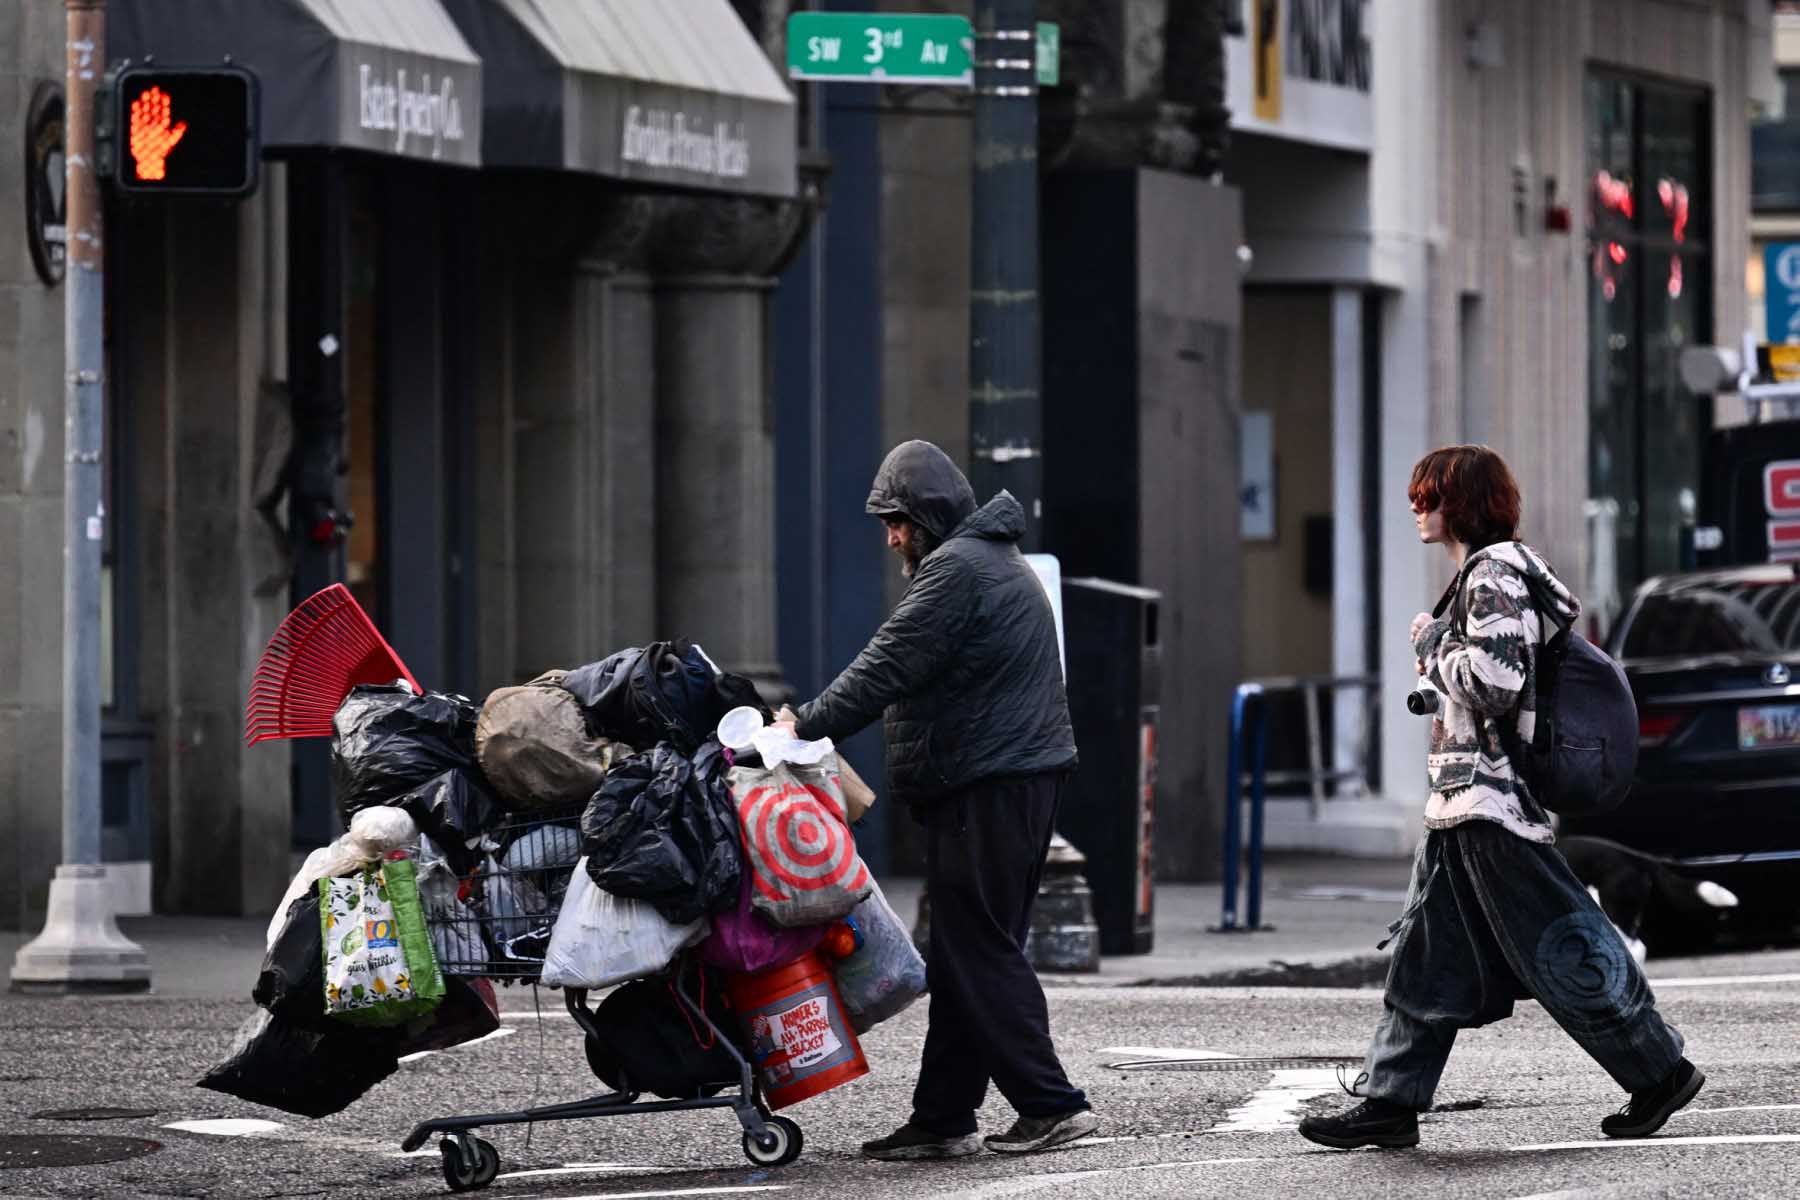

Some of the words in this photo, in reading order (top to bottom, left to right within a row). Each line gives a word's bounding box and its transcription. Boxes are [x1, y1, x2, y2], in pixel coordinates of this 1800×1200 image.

[808, 36, 842, 62] SW
[863, 27, 904, 64] 3rd
[920, 40, 949, 64] Av
[790, 1033, 825, 1057] BUCKET
